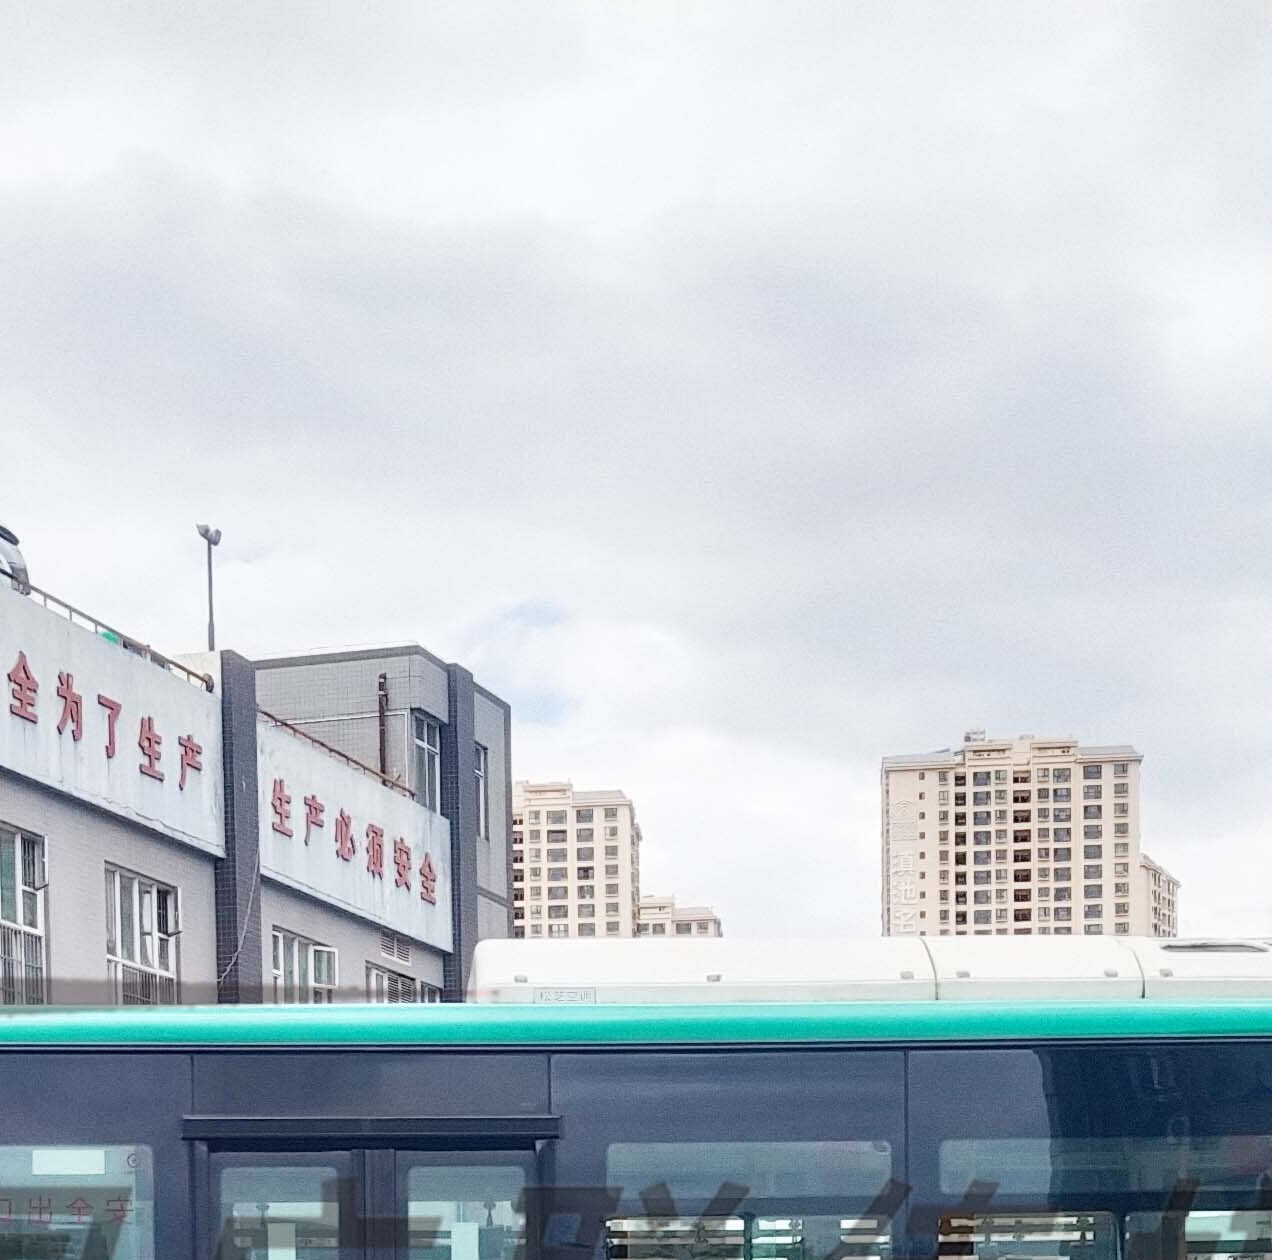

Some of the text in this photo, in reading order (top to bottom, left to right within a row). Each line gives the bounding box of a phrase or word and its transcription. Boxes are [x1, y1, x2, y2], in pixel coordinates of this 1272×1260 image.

[272, 778, 437, 905] 生产必须安全
